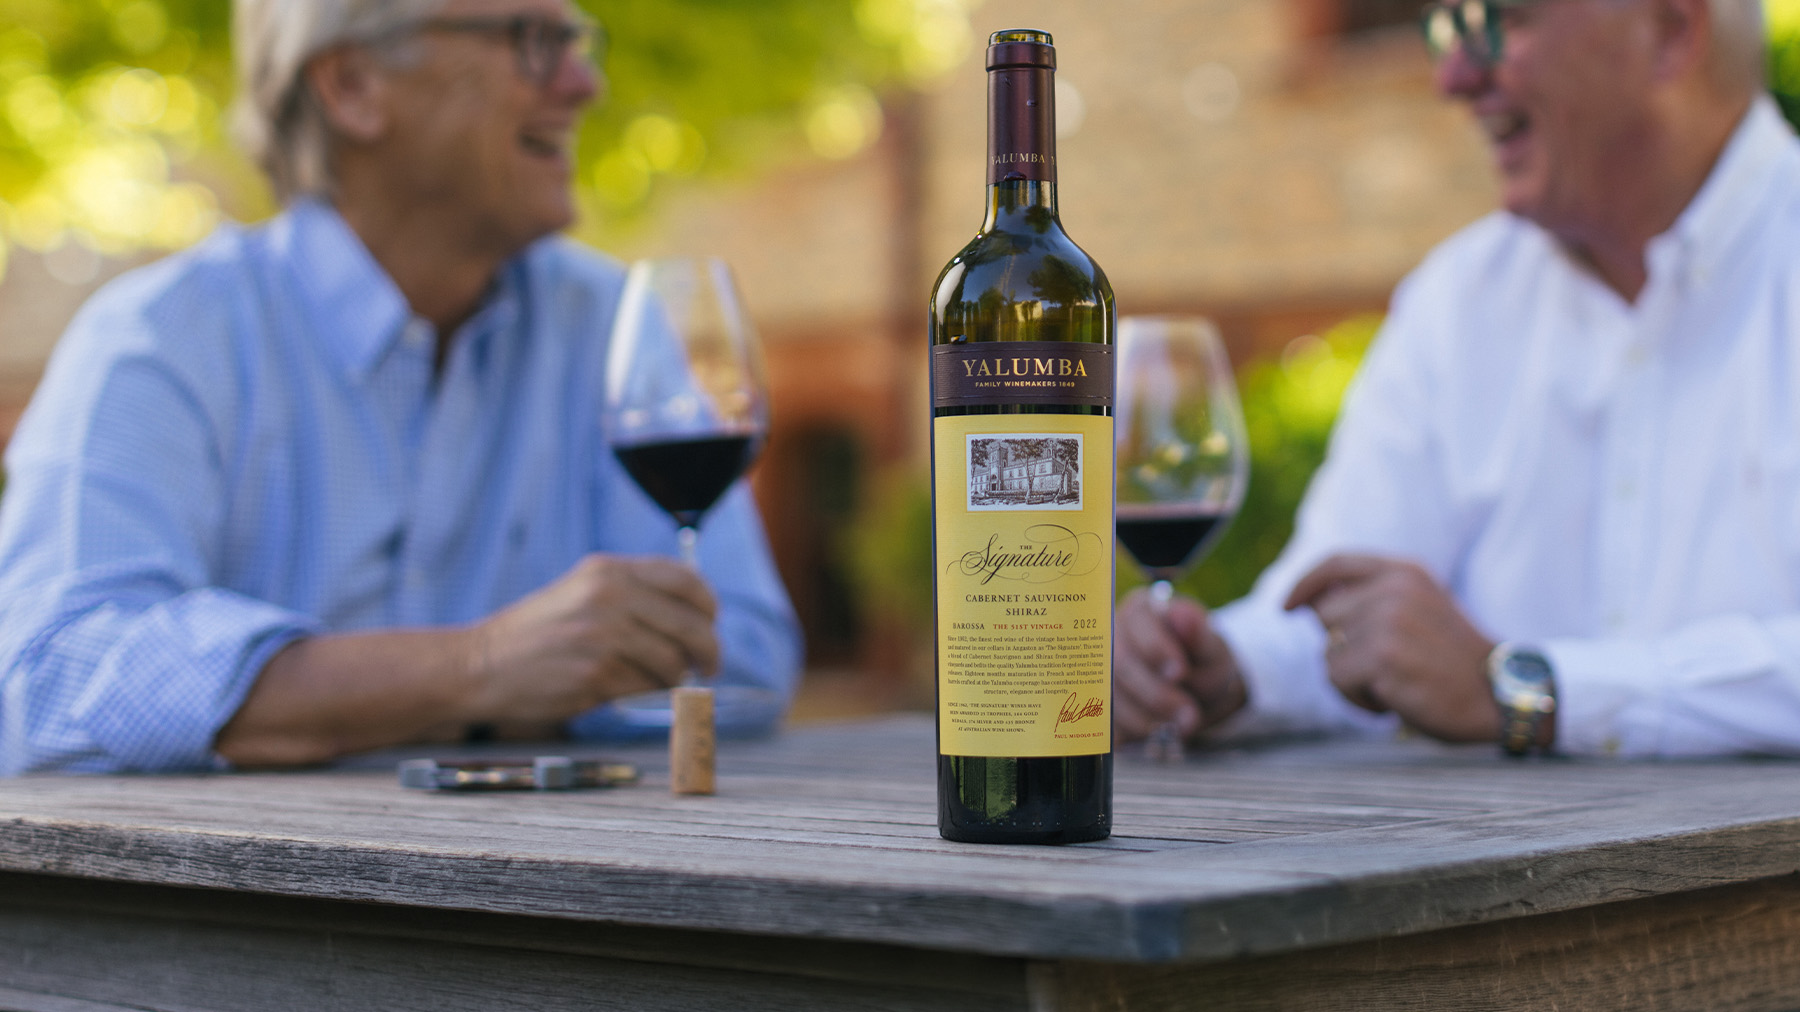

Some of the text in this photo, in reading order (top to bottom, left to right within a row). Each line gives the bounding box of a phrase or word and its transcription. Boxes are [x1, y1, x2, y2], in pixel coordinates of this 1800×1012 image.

[962, 358, 1088, 377] YALUMBA
[959, 533, 1074, 586] Signature
[966, 594, 1086, 603] CABERNET SAUVIGNON
[1006, 608, 1048, 616] SHIRAZ
[952, 622, 985, 630] BAROSSA
[1073, 618, 1097, 629] 2022
